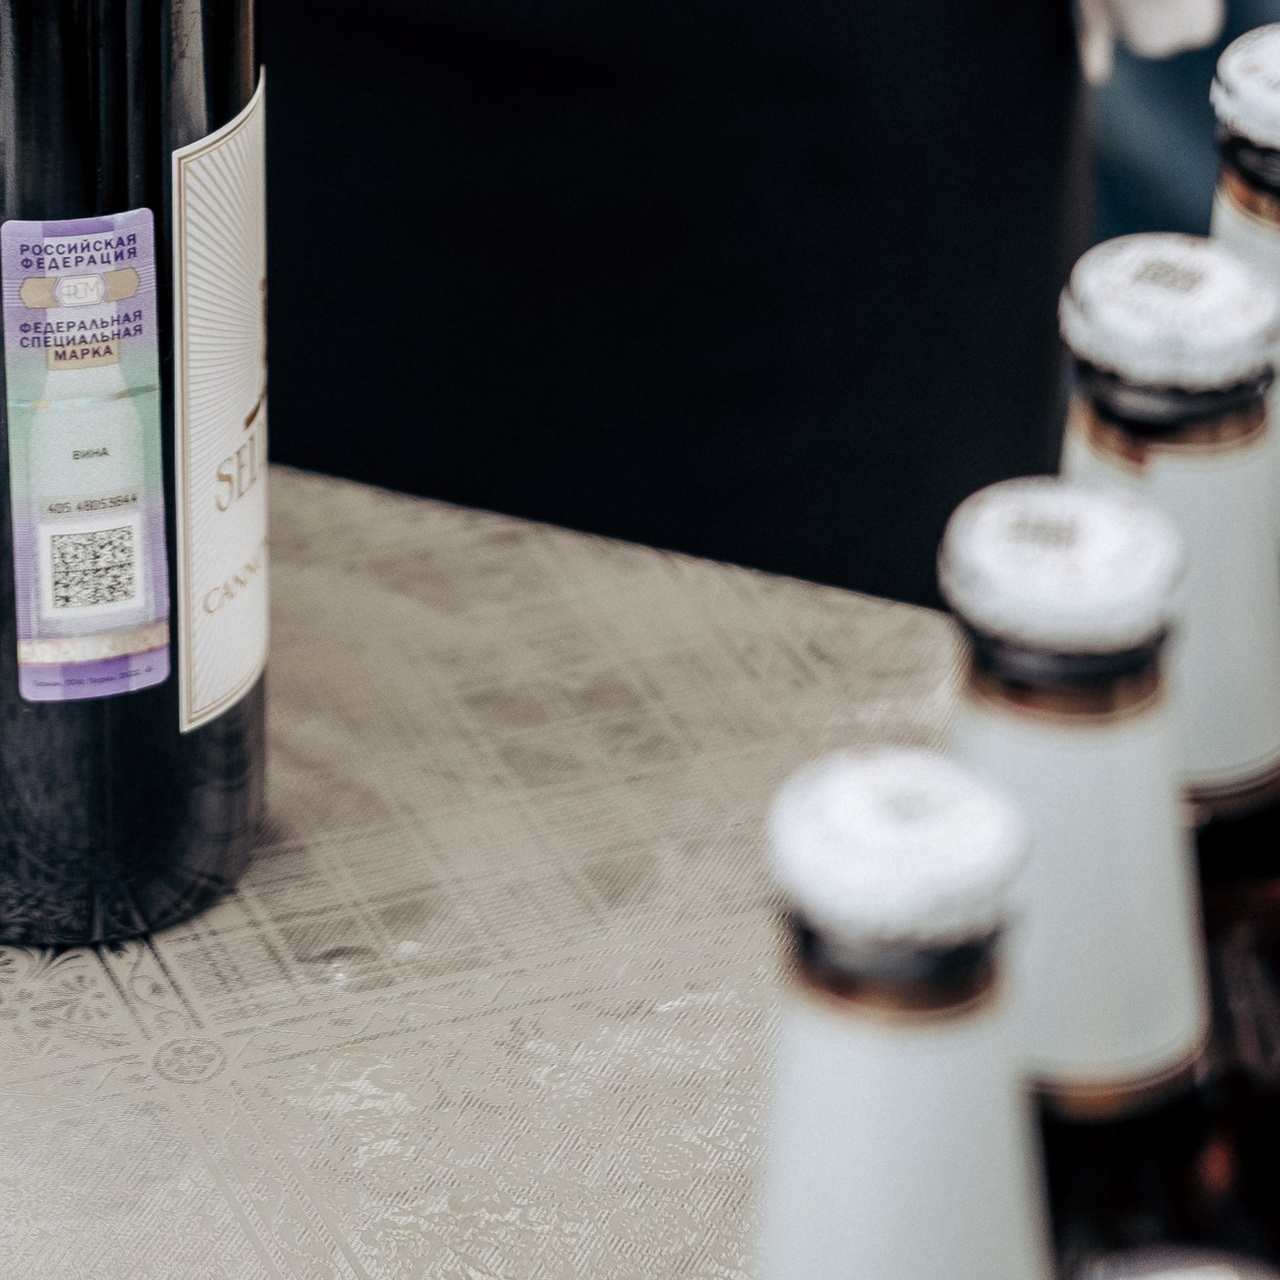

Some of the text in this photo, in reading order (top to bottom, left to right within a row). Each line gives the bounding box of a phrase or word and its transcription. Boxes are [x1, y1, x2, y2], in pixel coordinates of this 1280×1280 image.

[20, 233, 138, 256] РОССИЙСКАЯ
[20, 247, 138, 271] ФЕДЕРАЦИЯ
[20, 309, 143, 335] ФЕДЕРАЛЬНАЯ
[20, 323, 144, 348] СПЕЦИАЛЬНАЯ
[54, 345, 114, 362] МАРКА
[72, 447, 110, 460] ВИНА
